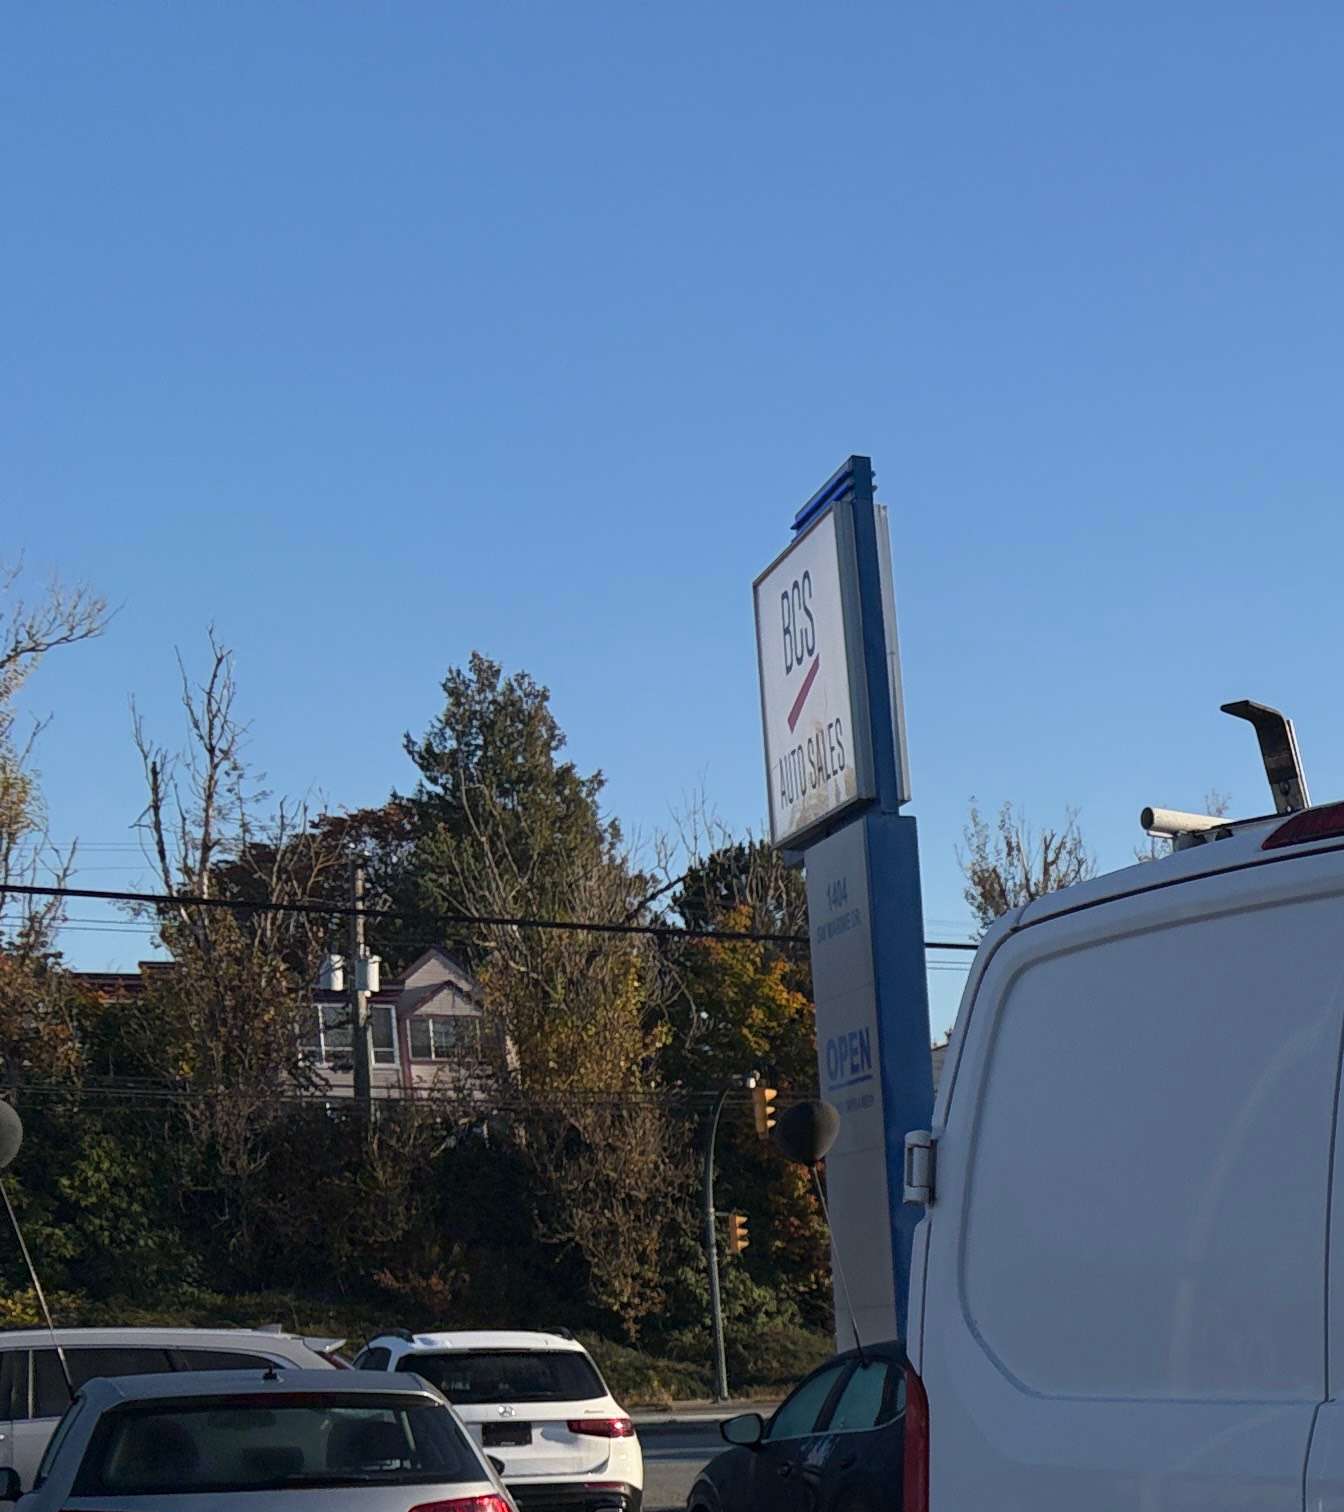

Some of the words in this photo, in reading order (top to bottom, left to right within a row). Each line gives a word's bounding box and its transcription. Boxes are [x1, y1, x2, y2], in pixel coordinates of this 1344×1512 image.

[781, 570, 816, 675] BCS
[779, 744, 807, 810] AUTO
[807, 717, 846, 789] SALES
[827, 1028, 872, 1080] OPEN
